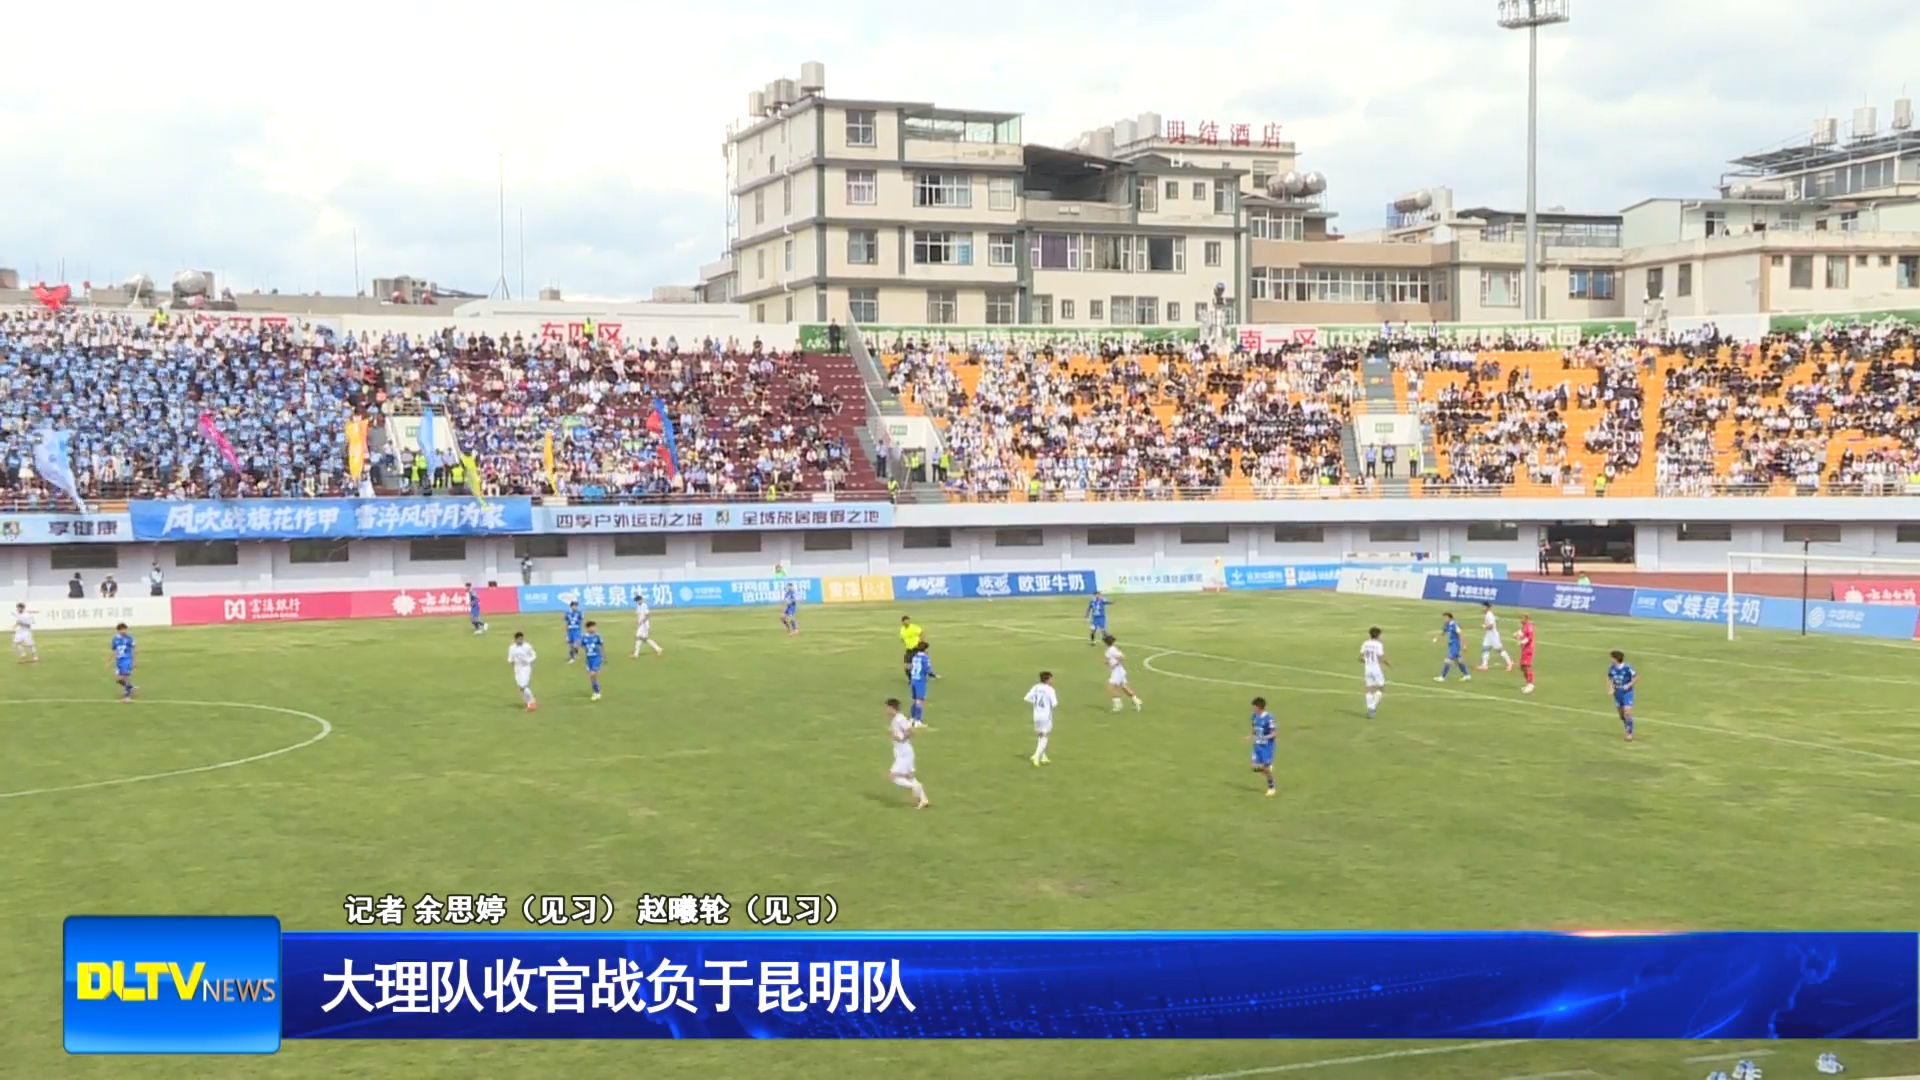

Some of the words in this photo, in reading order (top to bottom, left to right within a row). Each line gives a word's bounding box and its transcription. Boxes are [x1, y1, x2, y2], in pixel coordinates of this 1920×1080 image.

[1240, 329, 1316, 350] 南一区
[557, 511, 703, 529] 四季户外运动之城
[742, 509, 880, 525] 全域旅居度假之地
[1018, 573, 1085, 592] 欧亚牛奶
[584, 584, 673, 607] 蝶泉牛奶
[1682, 594, 1761, 624] 蝶泉牛奶
